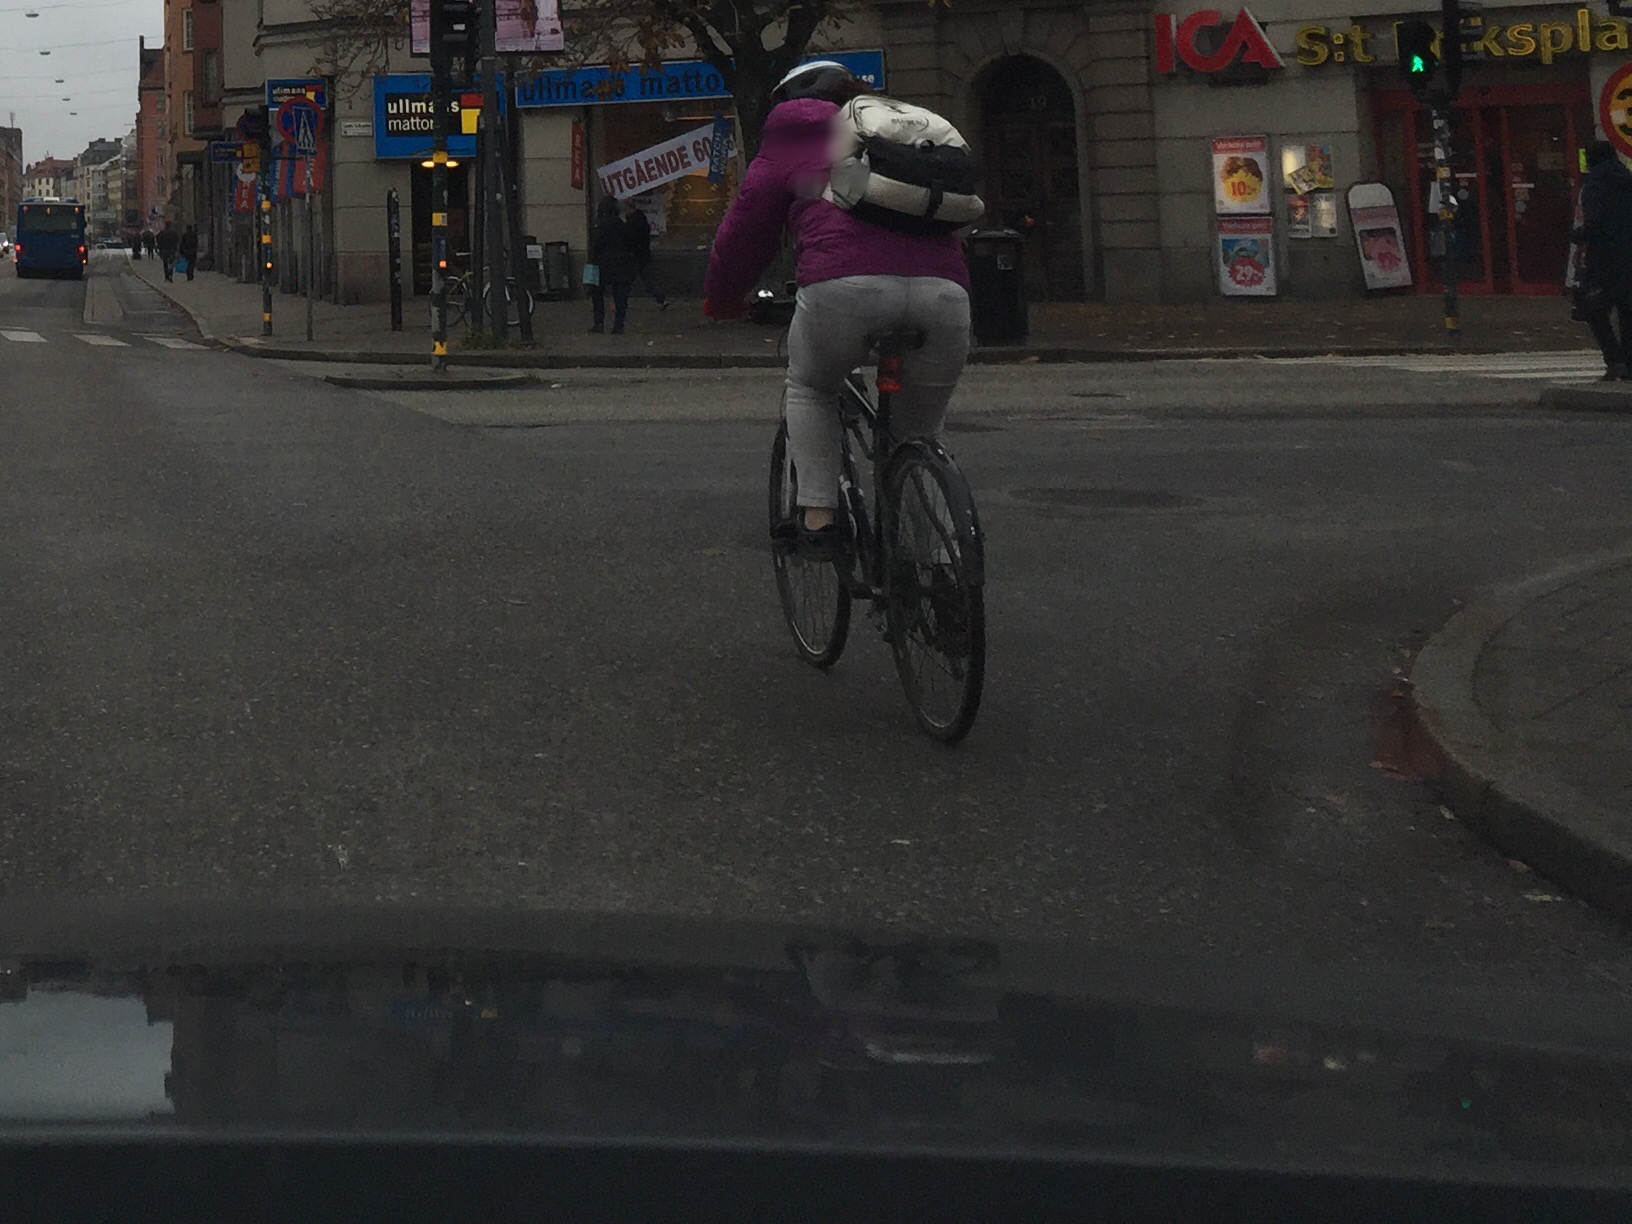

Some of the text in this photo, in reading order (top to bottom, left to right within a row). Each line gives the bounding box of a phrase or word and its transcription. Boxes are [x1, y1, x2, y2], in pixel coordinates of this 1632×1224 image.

[1154, 7, 1285, 74] ICA
[639, 70, 720, 96] matto
[388, 98, 460, 114] ullmas
[600, 144, 692, 197] UTGÅENDE
